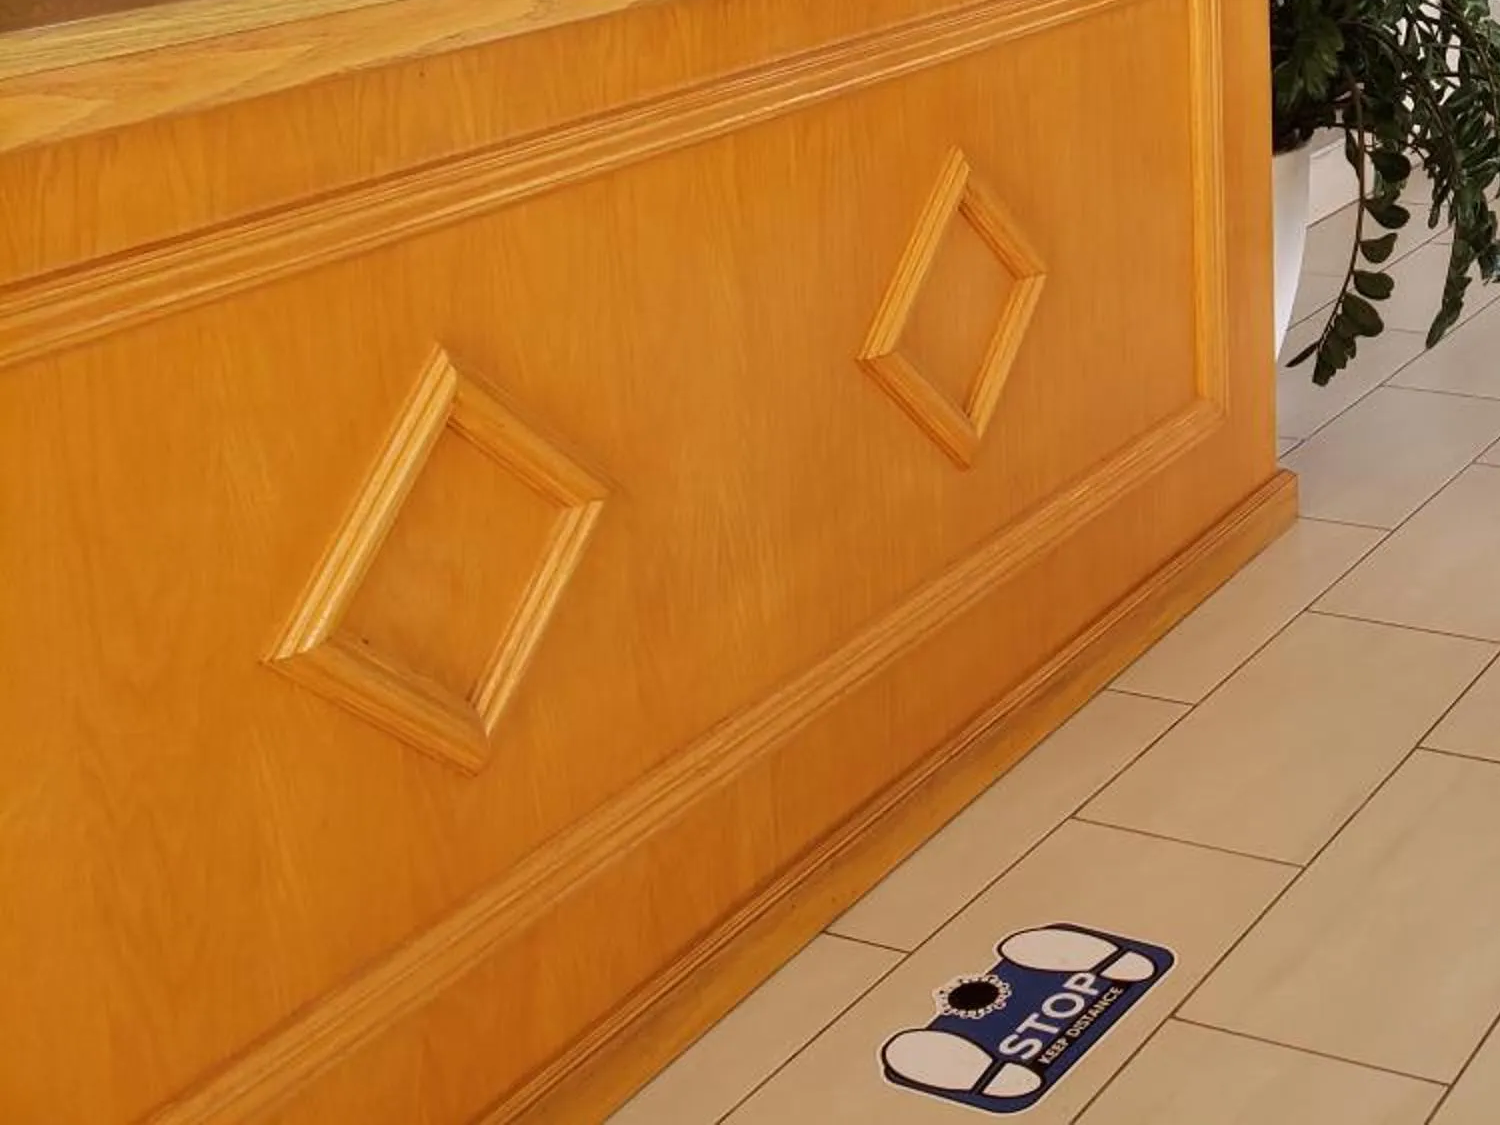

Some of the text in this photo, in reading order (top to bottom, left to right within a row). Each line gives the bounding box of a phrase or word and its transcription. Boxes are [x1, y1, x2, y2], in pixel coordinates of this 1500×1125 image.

[999, 973, 1099, 1060] STOP
[1038, 986, 1124, 1065] KEEP DISTANCE
